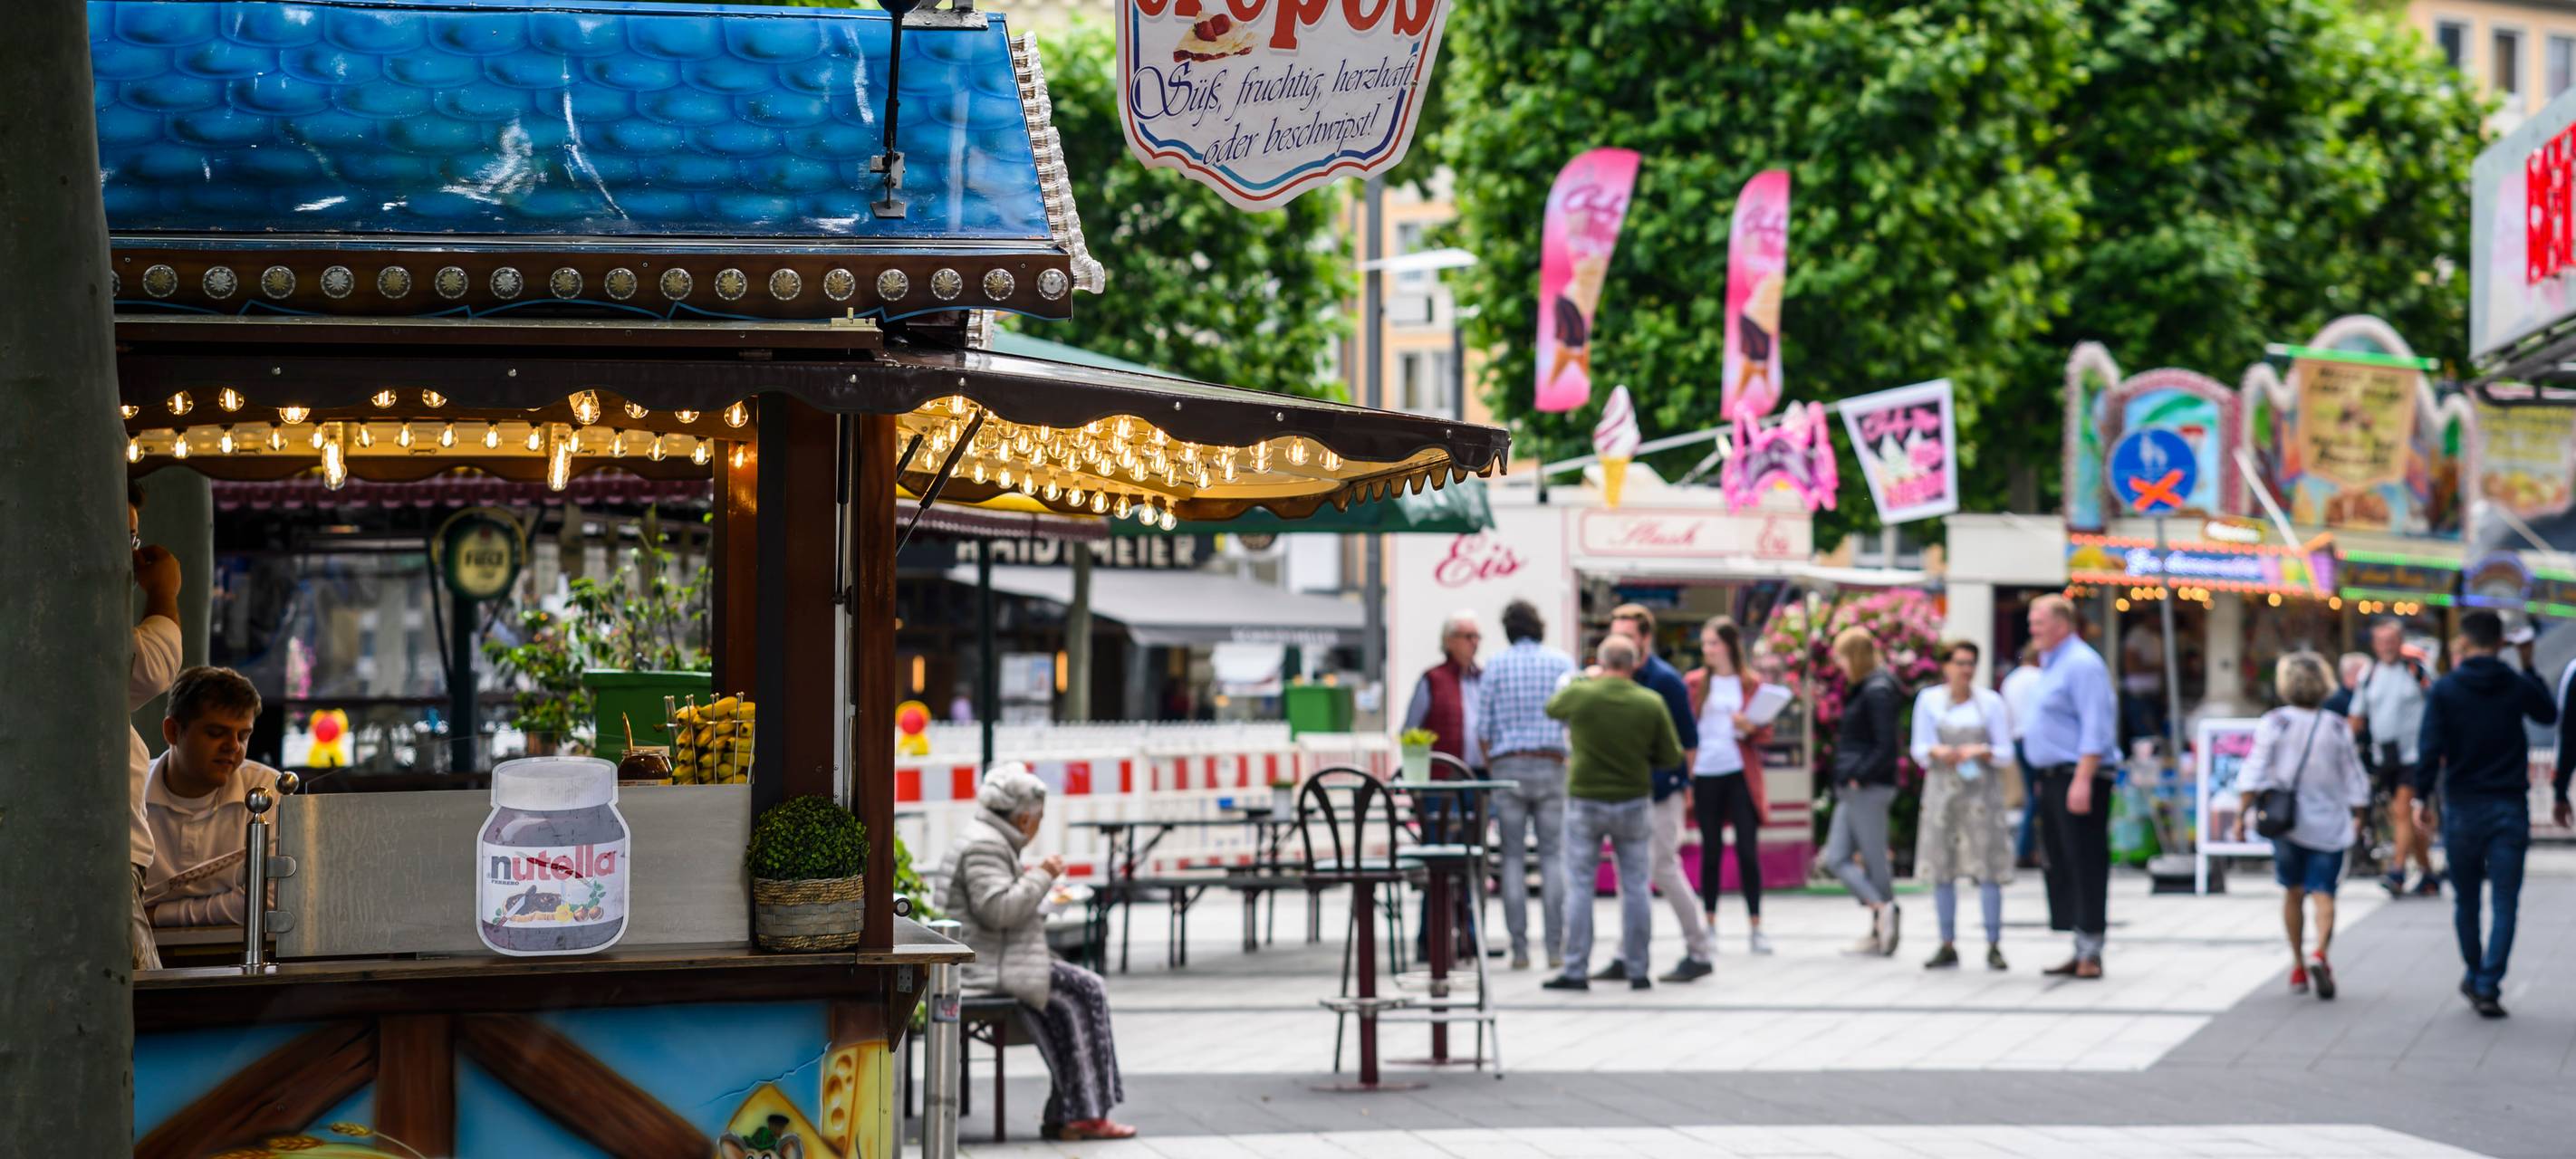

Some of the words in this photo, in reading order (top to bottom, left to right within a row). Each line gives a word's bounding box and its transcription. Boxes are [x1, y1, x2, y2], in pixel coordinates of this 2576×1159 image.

[1130, 61, 1226, 127] Süß,
[1225, 64, 1325, 121] fruchtig,
[1331, 53, 1418, 100] herzhaft
[1202, 123, 1259, 166] oder
[1263, 104, 1380, 154] beschwipst!
[1434, 532, 1526, 588] Eis
[491, 844, 618, 882] nutella
